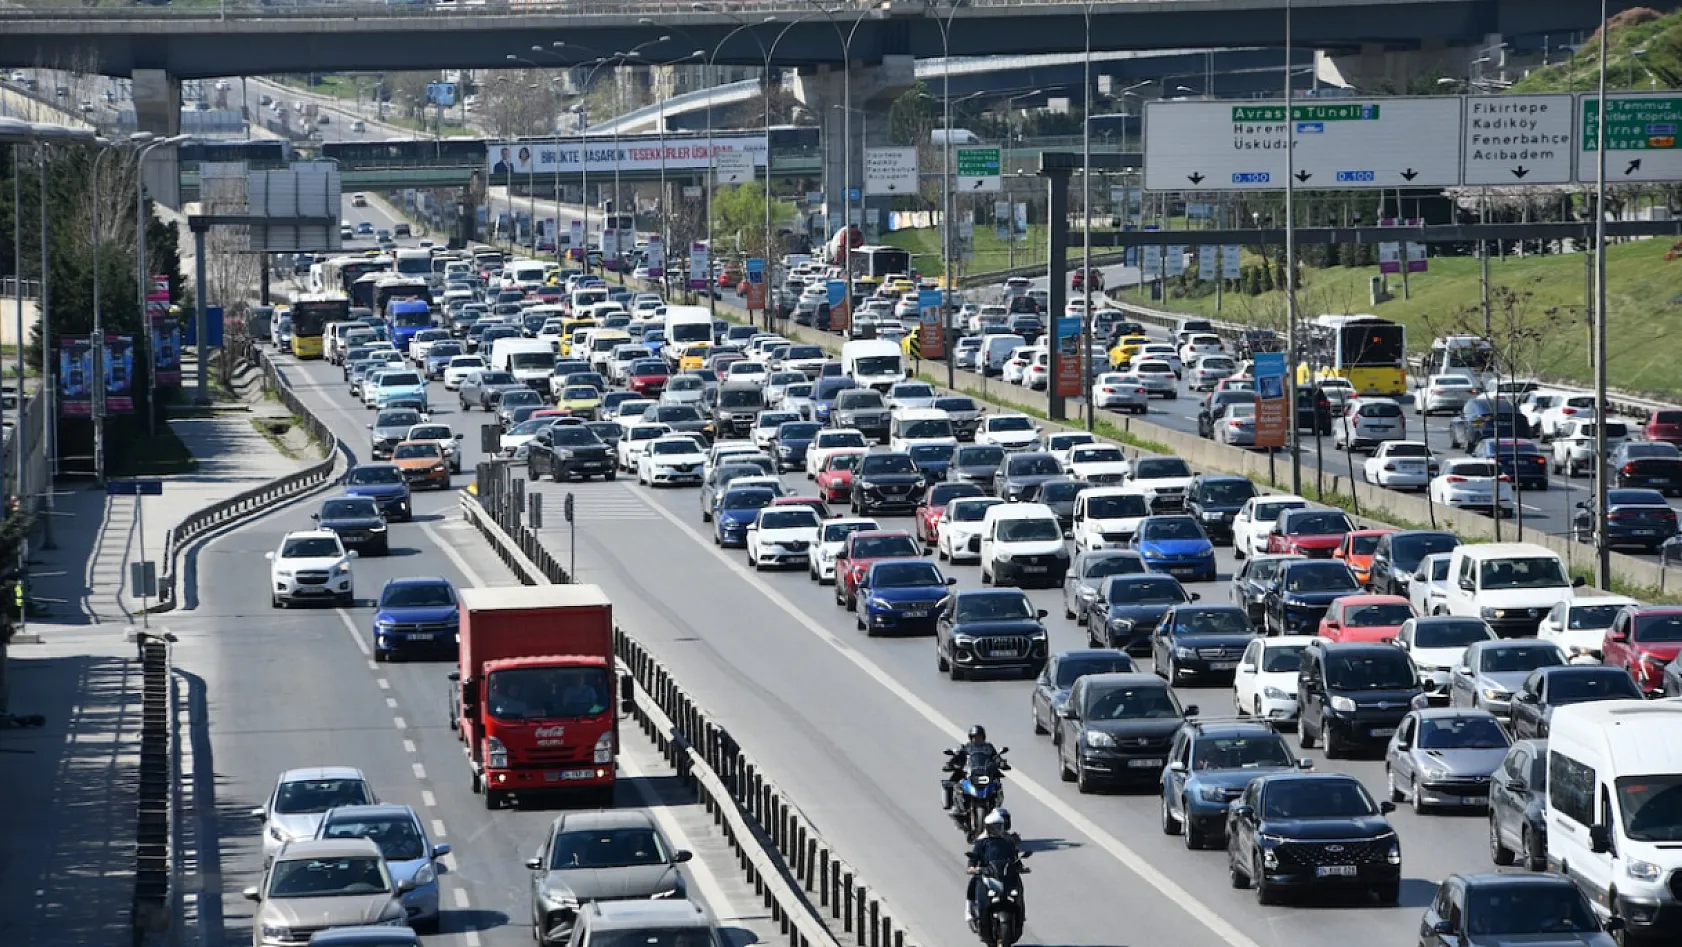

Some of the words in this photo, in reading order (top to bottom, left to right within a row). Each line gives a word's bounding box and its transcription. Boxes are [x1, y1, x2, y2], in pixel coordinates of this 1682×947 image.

[1473, 103, 1548, 115] Fikirtepe
[1618, 101, 1672, 110] Temmuz
[1306, 106, 1360, 118] Tüneli
[1234, 124, 1288, 134] Harem
[1473, 117, 1537, 130] Kadıköy
[1586, 124, 1641, 135] Eirne
[1472, 132, 1569, 145] Fenerbahçe
[1587, 138, 1646, 149] Akara
[1473, 149, 1554, 160] Acıbadem
